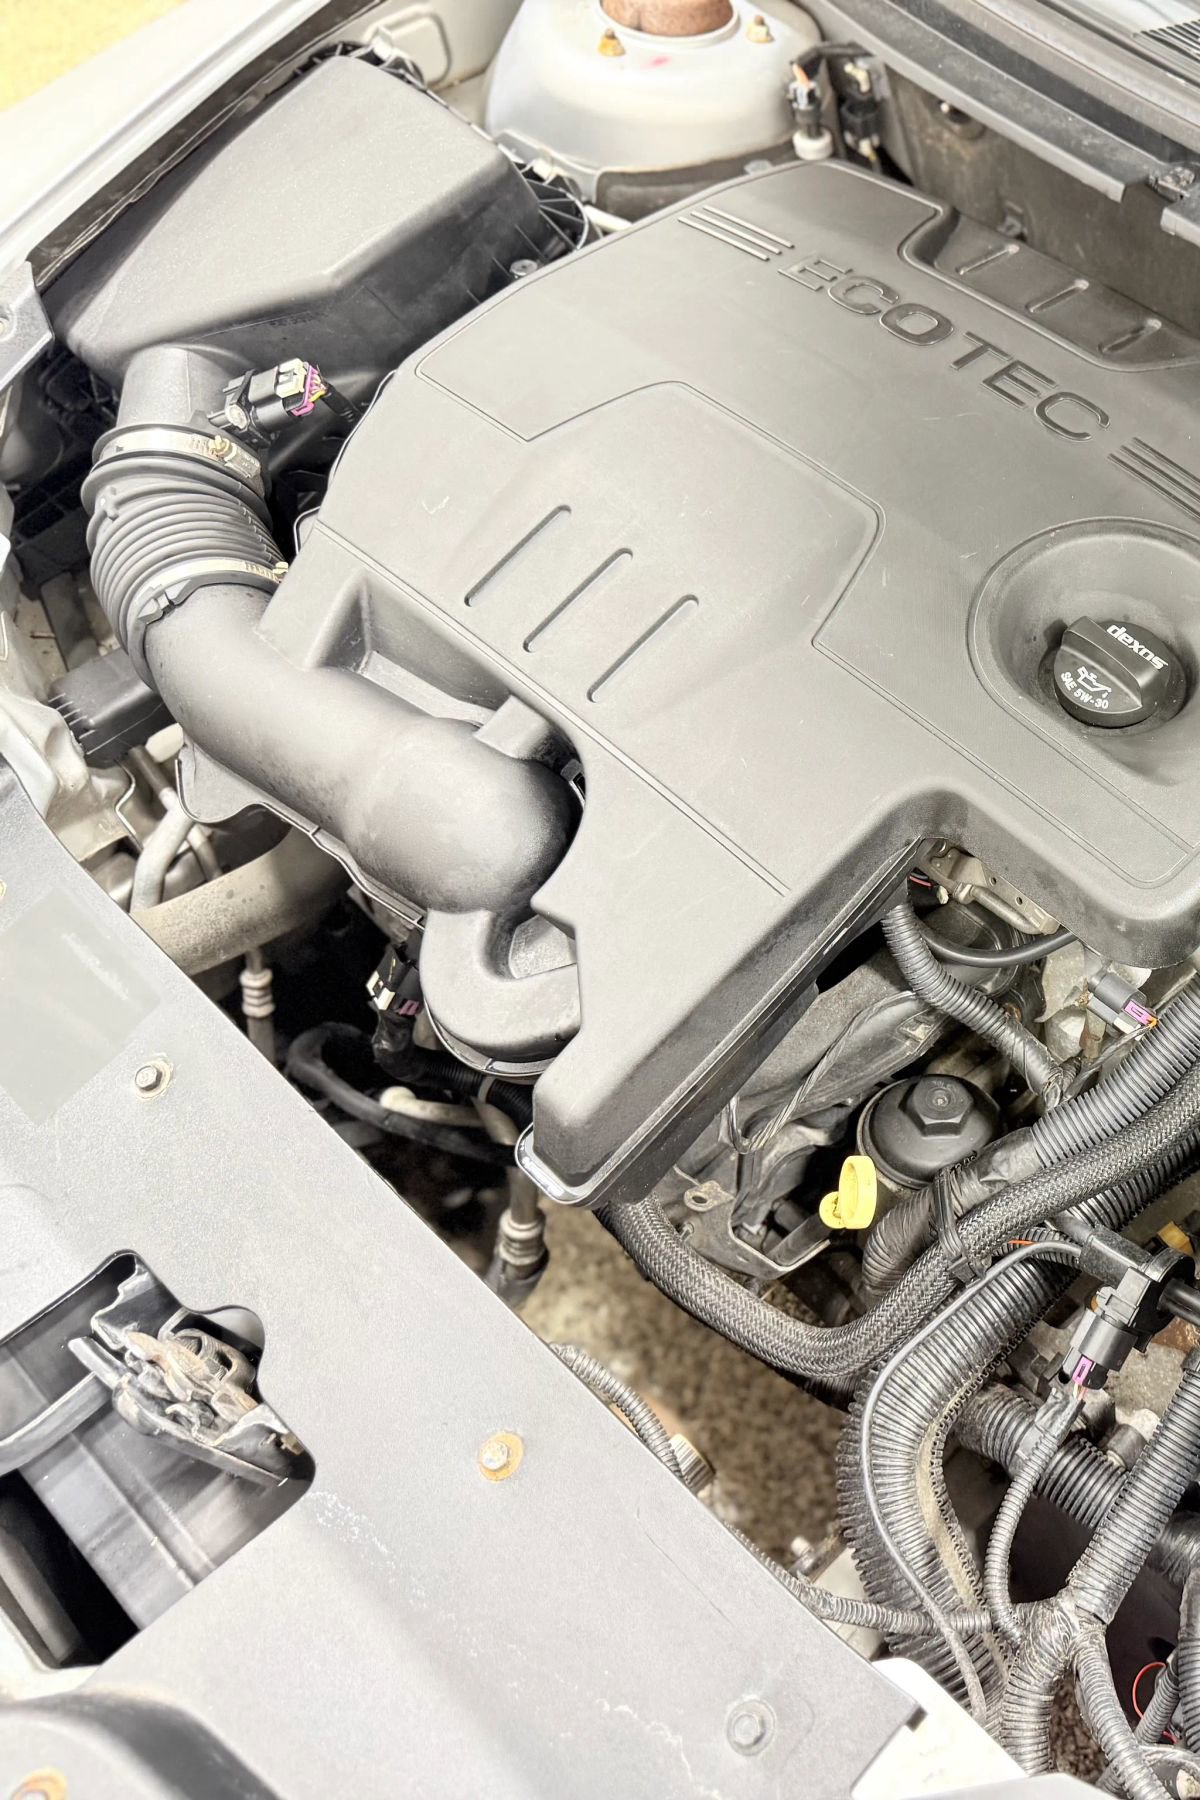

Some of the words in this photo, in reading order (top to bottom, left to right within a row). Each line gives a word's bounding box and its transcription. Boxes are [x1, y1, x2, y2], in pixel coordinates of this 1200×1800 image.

[777, 255, 1111, 442] ECOTEC
[1106, 624, 1169, 670] dexos
[1060, 671, 1078, 691] SAE
[1073, 688, 1109, 710] 5W-30
